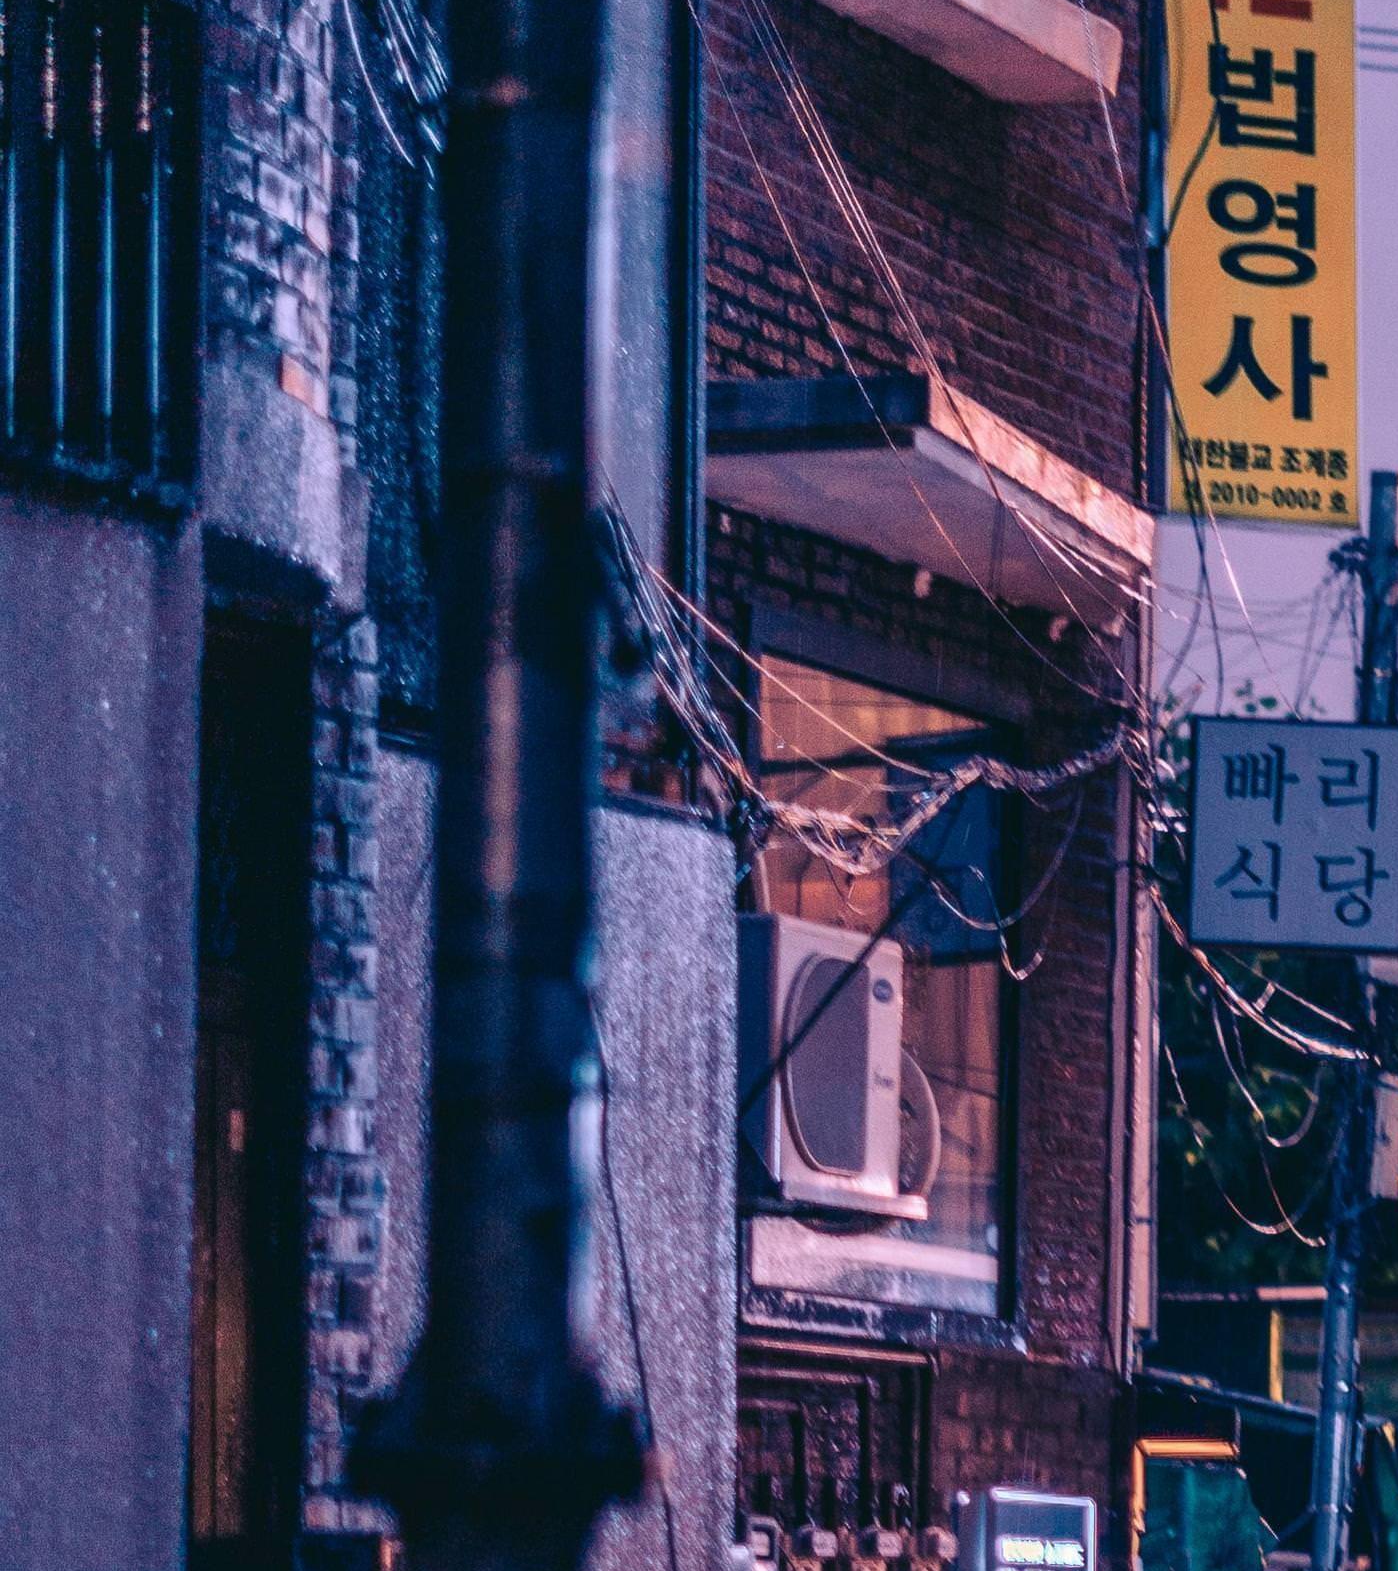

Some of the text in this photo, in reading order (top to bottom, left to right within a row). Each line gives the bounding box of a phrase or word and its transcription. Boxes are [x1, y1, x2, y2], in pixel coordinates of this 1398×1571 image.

[1200, 38, 1330, 424] 법영사
[1222, 742, 1381, 833] 빠리
[1213, 839, 1391, 928] 식당
